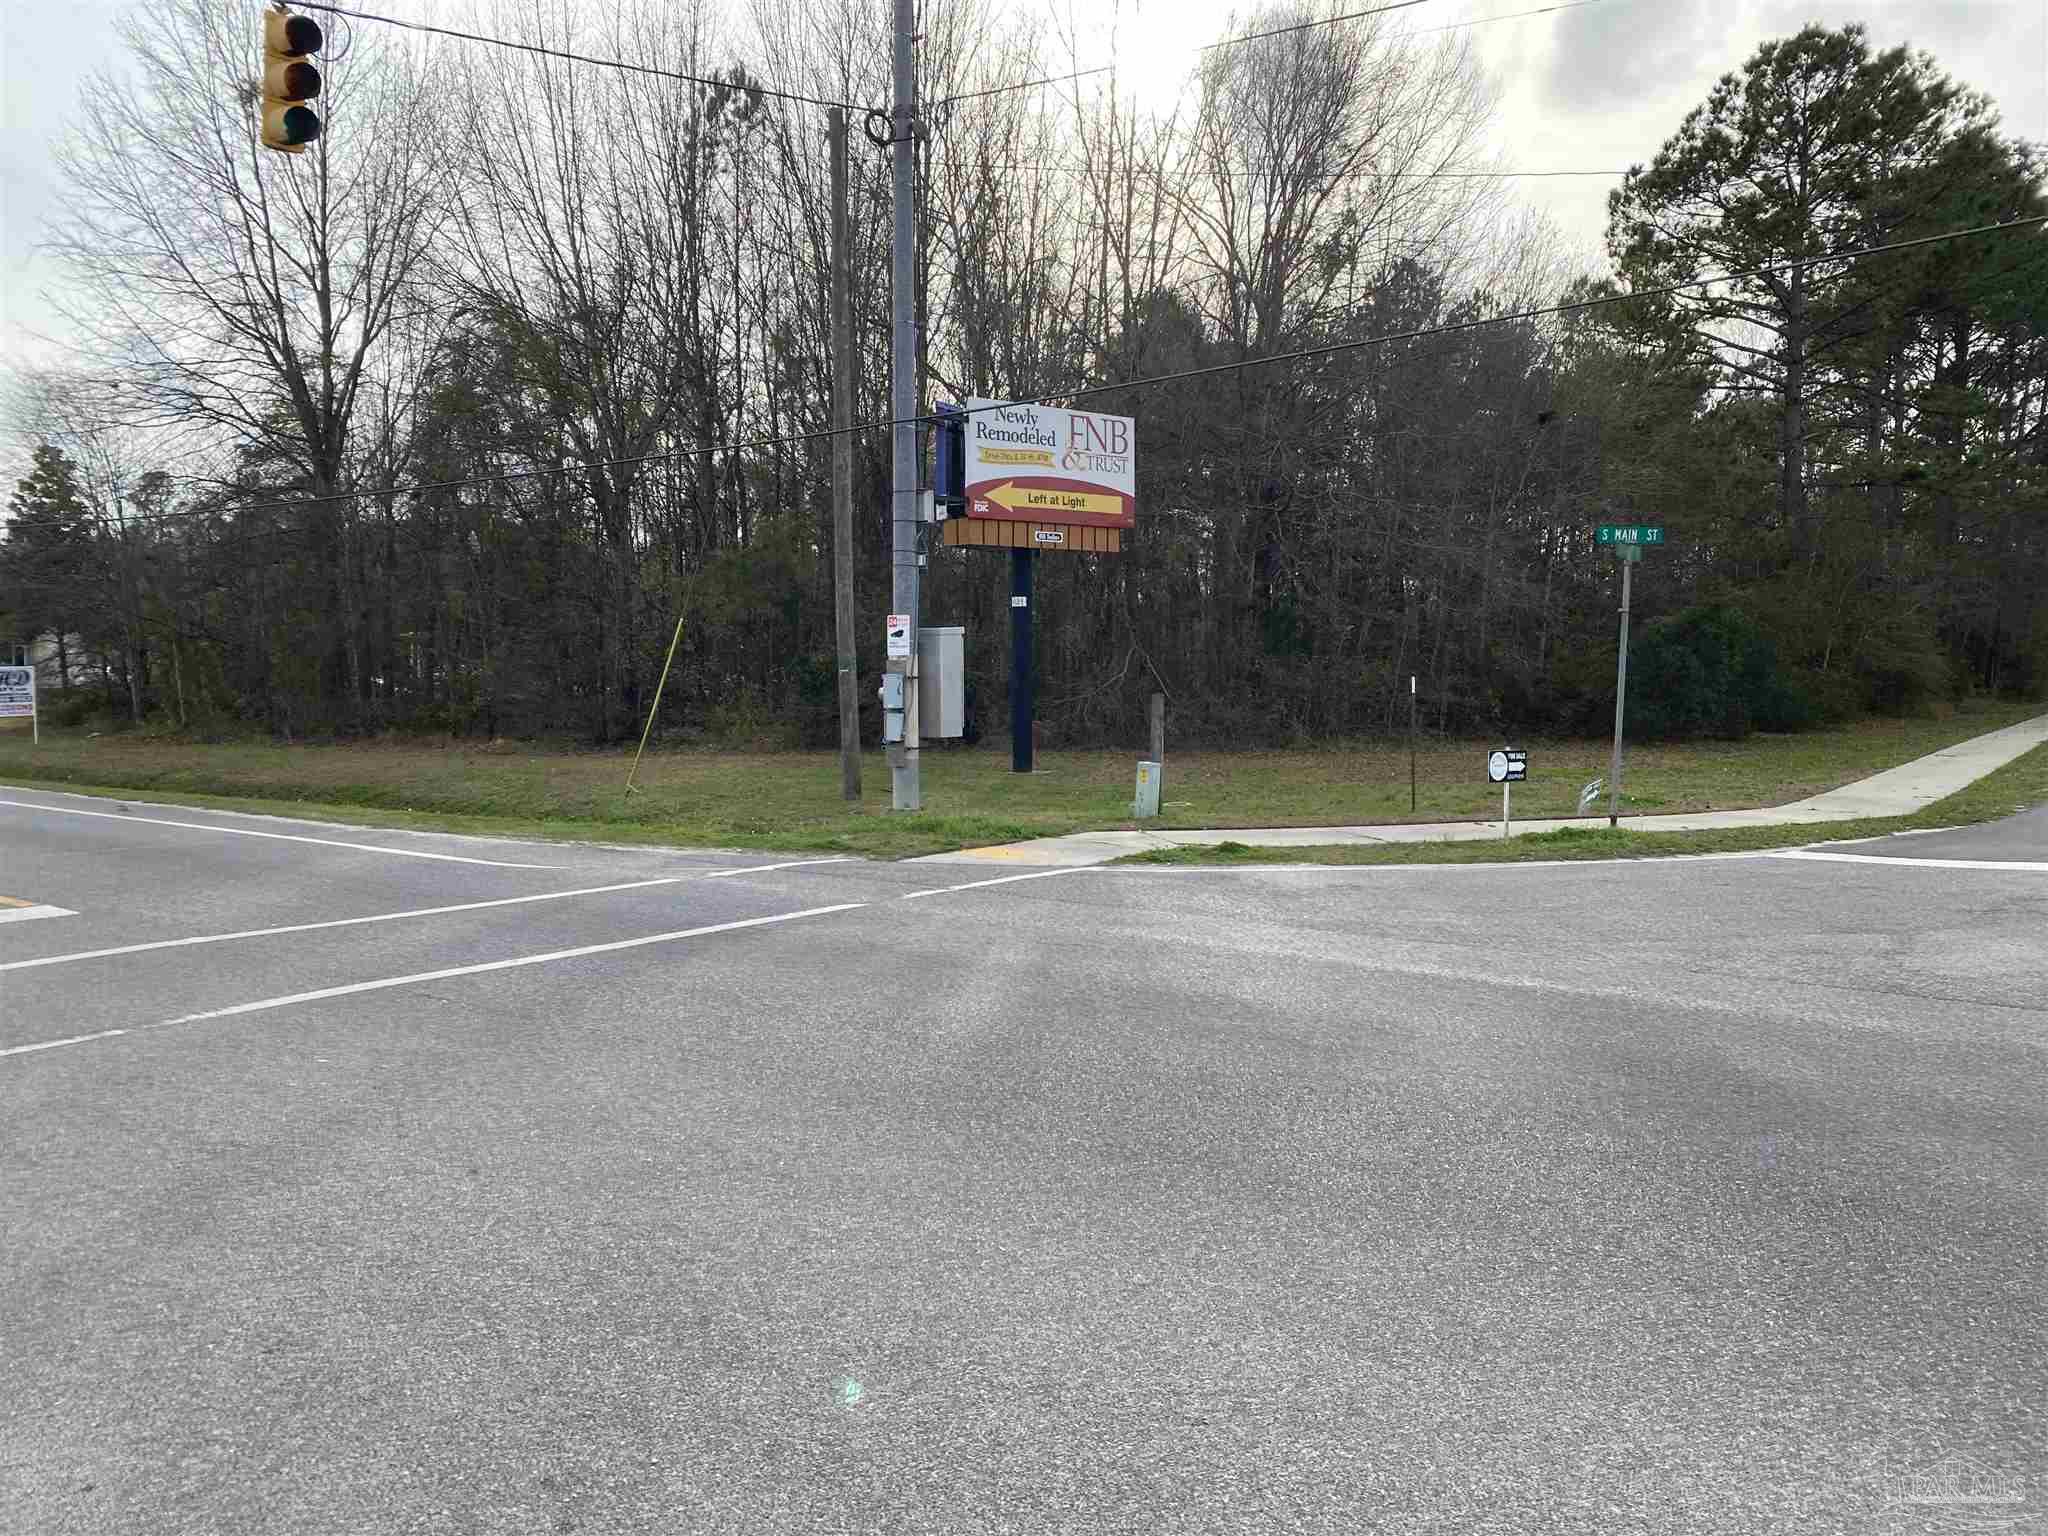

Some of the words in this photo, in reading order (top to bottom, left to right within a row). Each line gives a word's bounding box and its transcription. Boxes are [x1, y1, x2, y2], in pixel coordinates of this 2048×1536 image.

[994, 405, 1039, 425] Newly
[975, 420, 1056, 447] Remodeled
[1068, 414, 1128, 455] FNB
[1087, 454, 1128, 474] TRUST
[974, 503, 990, 512] FDIC
[1028, 493, 1047, 505] Left
[1049, 495, 1061, 505] at
[1062, 496, 1085, 509] Light
[1601, 528, 1609, 541] S
[1614, 528, 1638, 542] MAIN
[1647, 528, 1658, 541] ST
